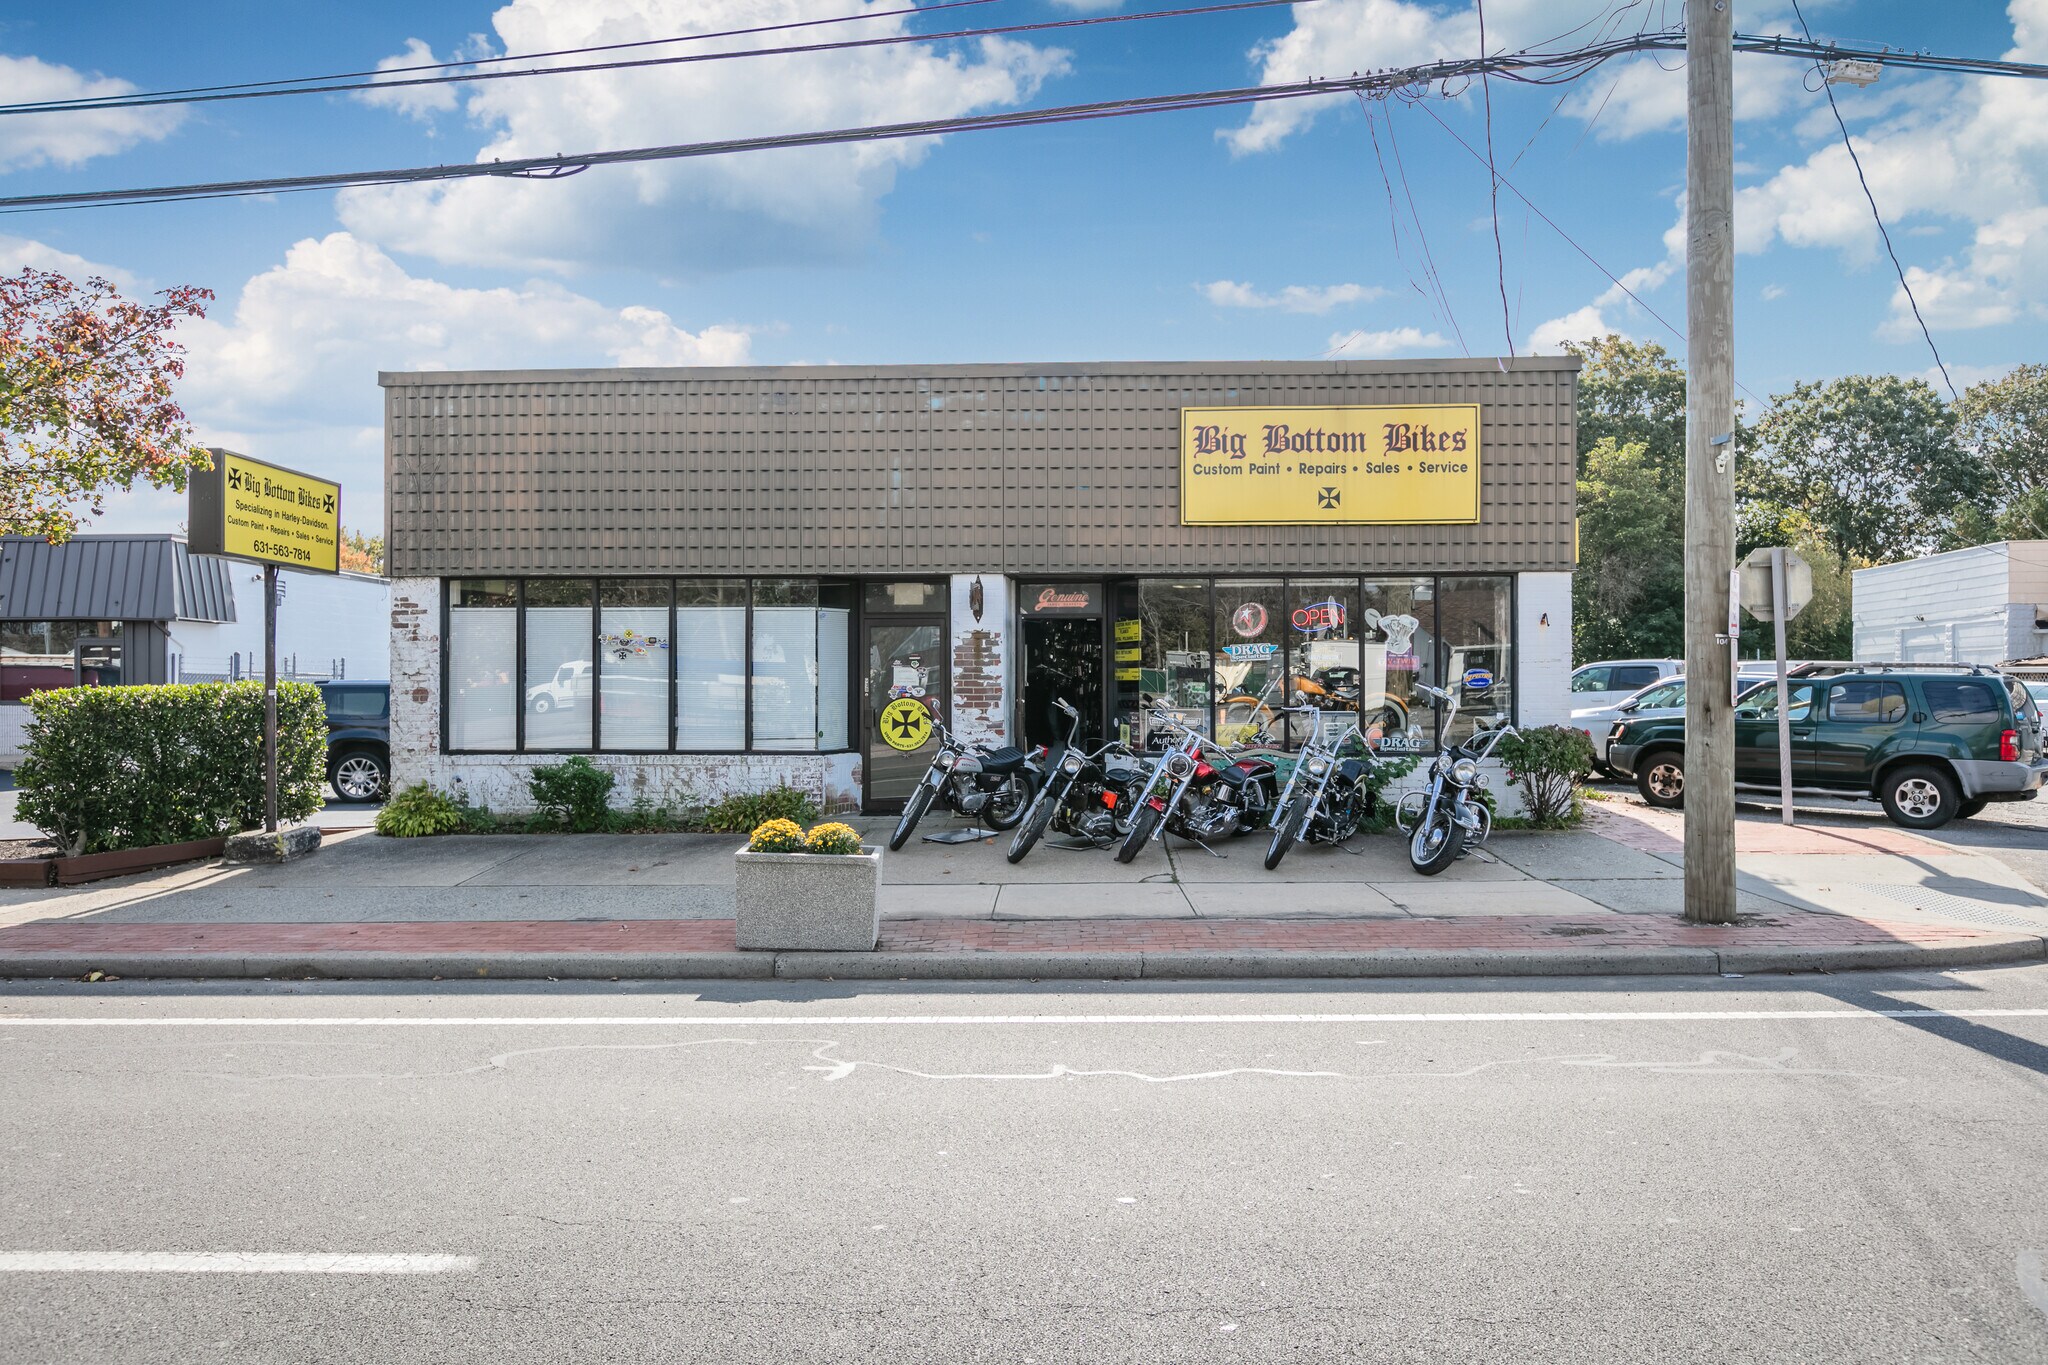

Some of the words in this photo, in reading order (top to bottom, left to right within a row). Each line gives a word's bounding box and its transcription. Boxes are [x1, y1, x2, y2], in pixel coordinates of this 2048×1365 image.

[1193, 425, 1247, 460] Big
[1262, 424, 1367, 458] Bottom
[1382, 423, 1468, 457] Bikes
[1192, 463, 1243, 475] Custom
[1249, 463, 1281, 475] Paint
[1299, 462, 1347, 477] Repairs
[1366, 462, 1400, 474] Sales
[1419, 461, 1468, 473] Service
[244, 472, 261, 498] Big
[264, 477, 295, 504] Bottom
[298, 487, 321, 510] Bikes
[235, 499, 273, 519] Specializing
[274, 510, 280, 519] in
[227, 515, 250, 527] Custom
[250, 520, 264, 530] Paint
[270, 525, 290, 537] Repairs
[296, 531, 310, 541] Sales
[315, 535, 334, 546] Service
[253, 540, 311, 562] 631-563-7814
[1035, 588, 1089, 611] Genuine
[1292, 608, 1345, 626] OPEN
[1231, 643, 1270, 655] DRAG
[882, 711, 894, 724] Big
[890, 701, 916, 711] Bottom
[1381, 737, 1421, 748] DRAG
